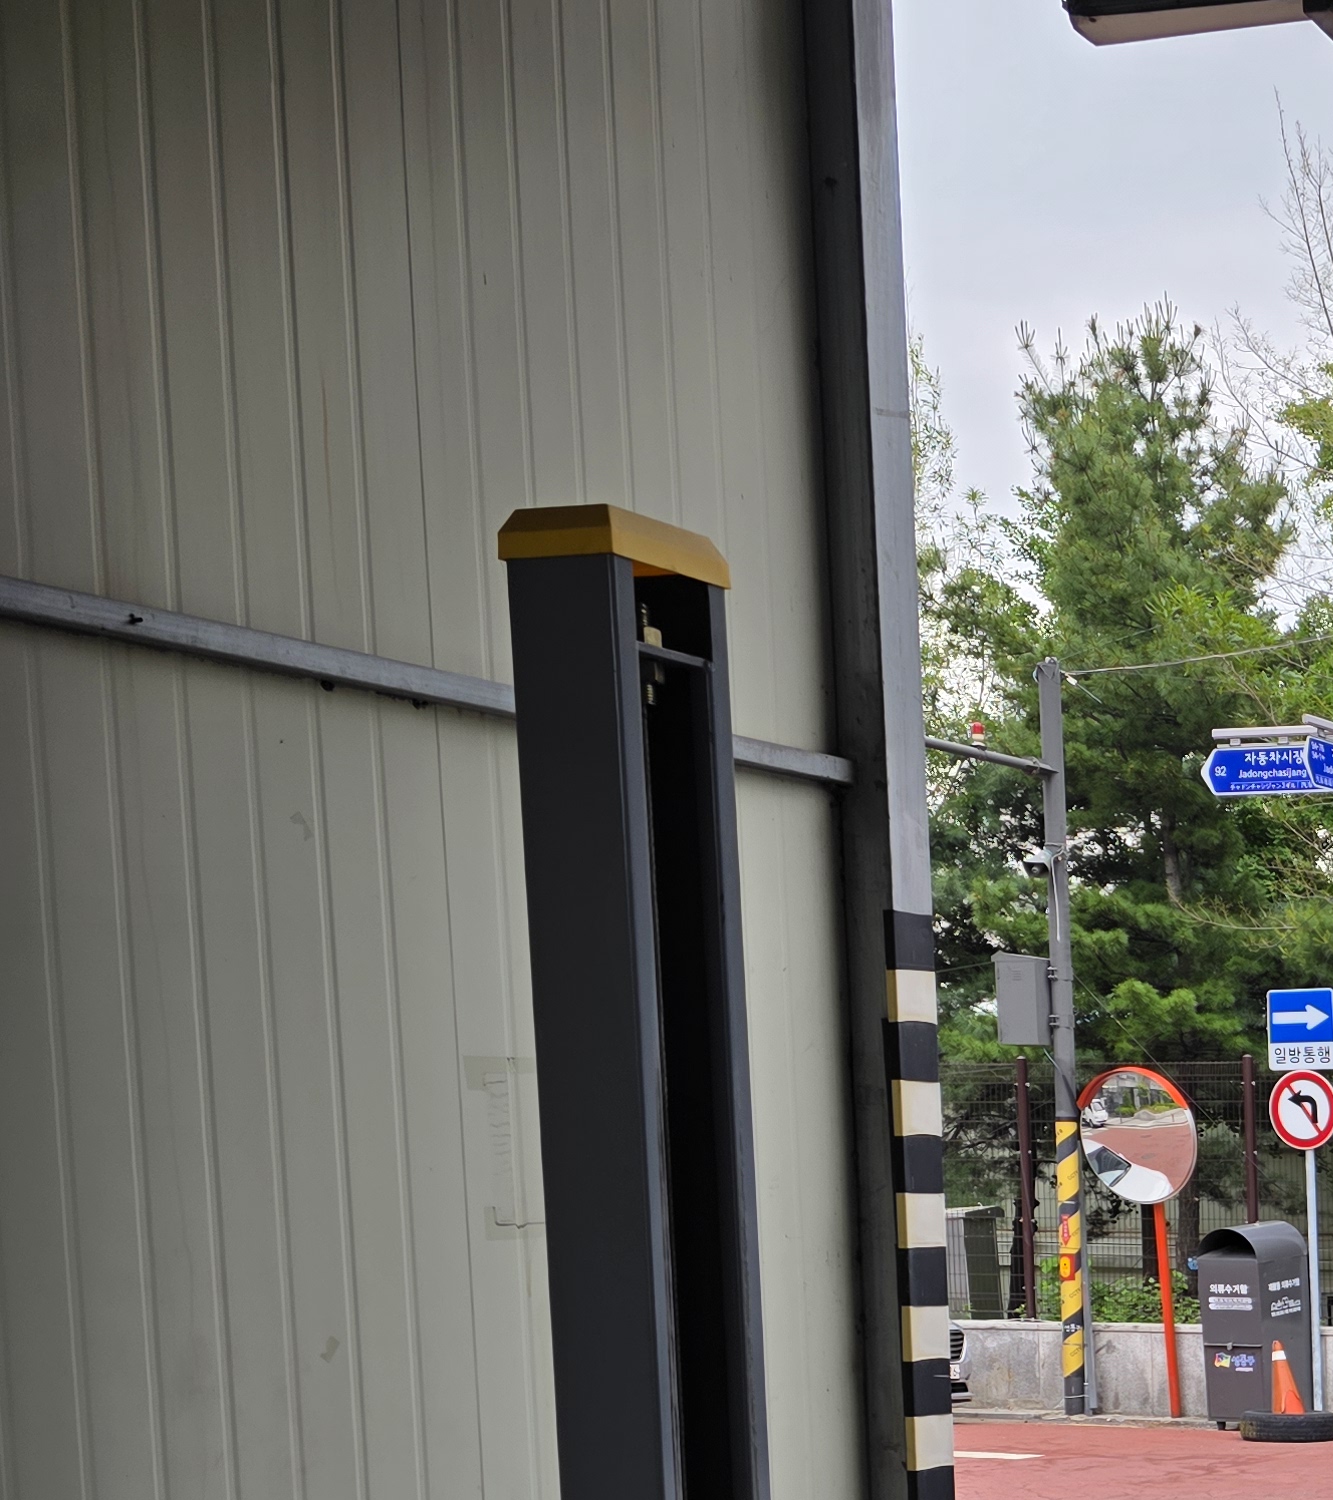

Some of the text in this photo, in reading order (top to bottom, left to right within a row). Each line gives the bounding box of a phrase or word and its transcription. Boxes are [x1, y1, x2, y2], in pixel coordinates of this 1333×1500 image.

[1214, 766, 1227, 777] 92
[1239, 768, 1307, 779] Jadongchasijang
[1274, 1046, 1331, 1065] 일방통행
[1209, 1284, 1249, 1294] 의류수거함
